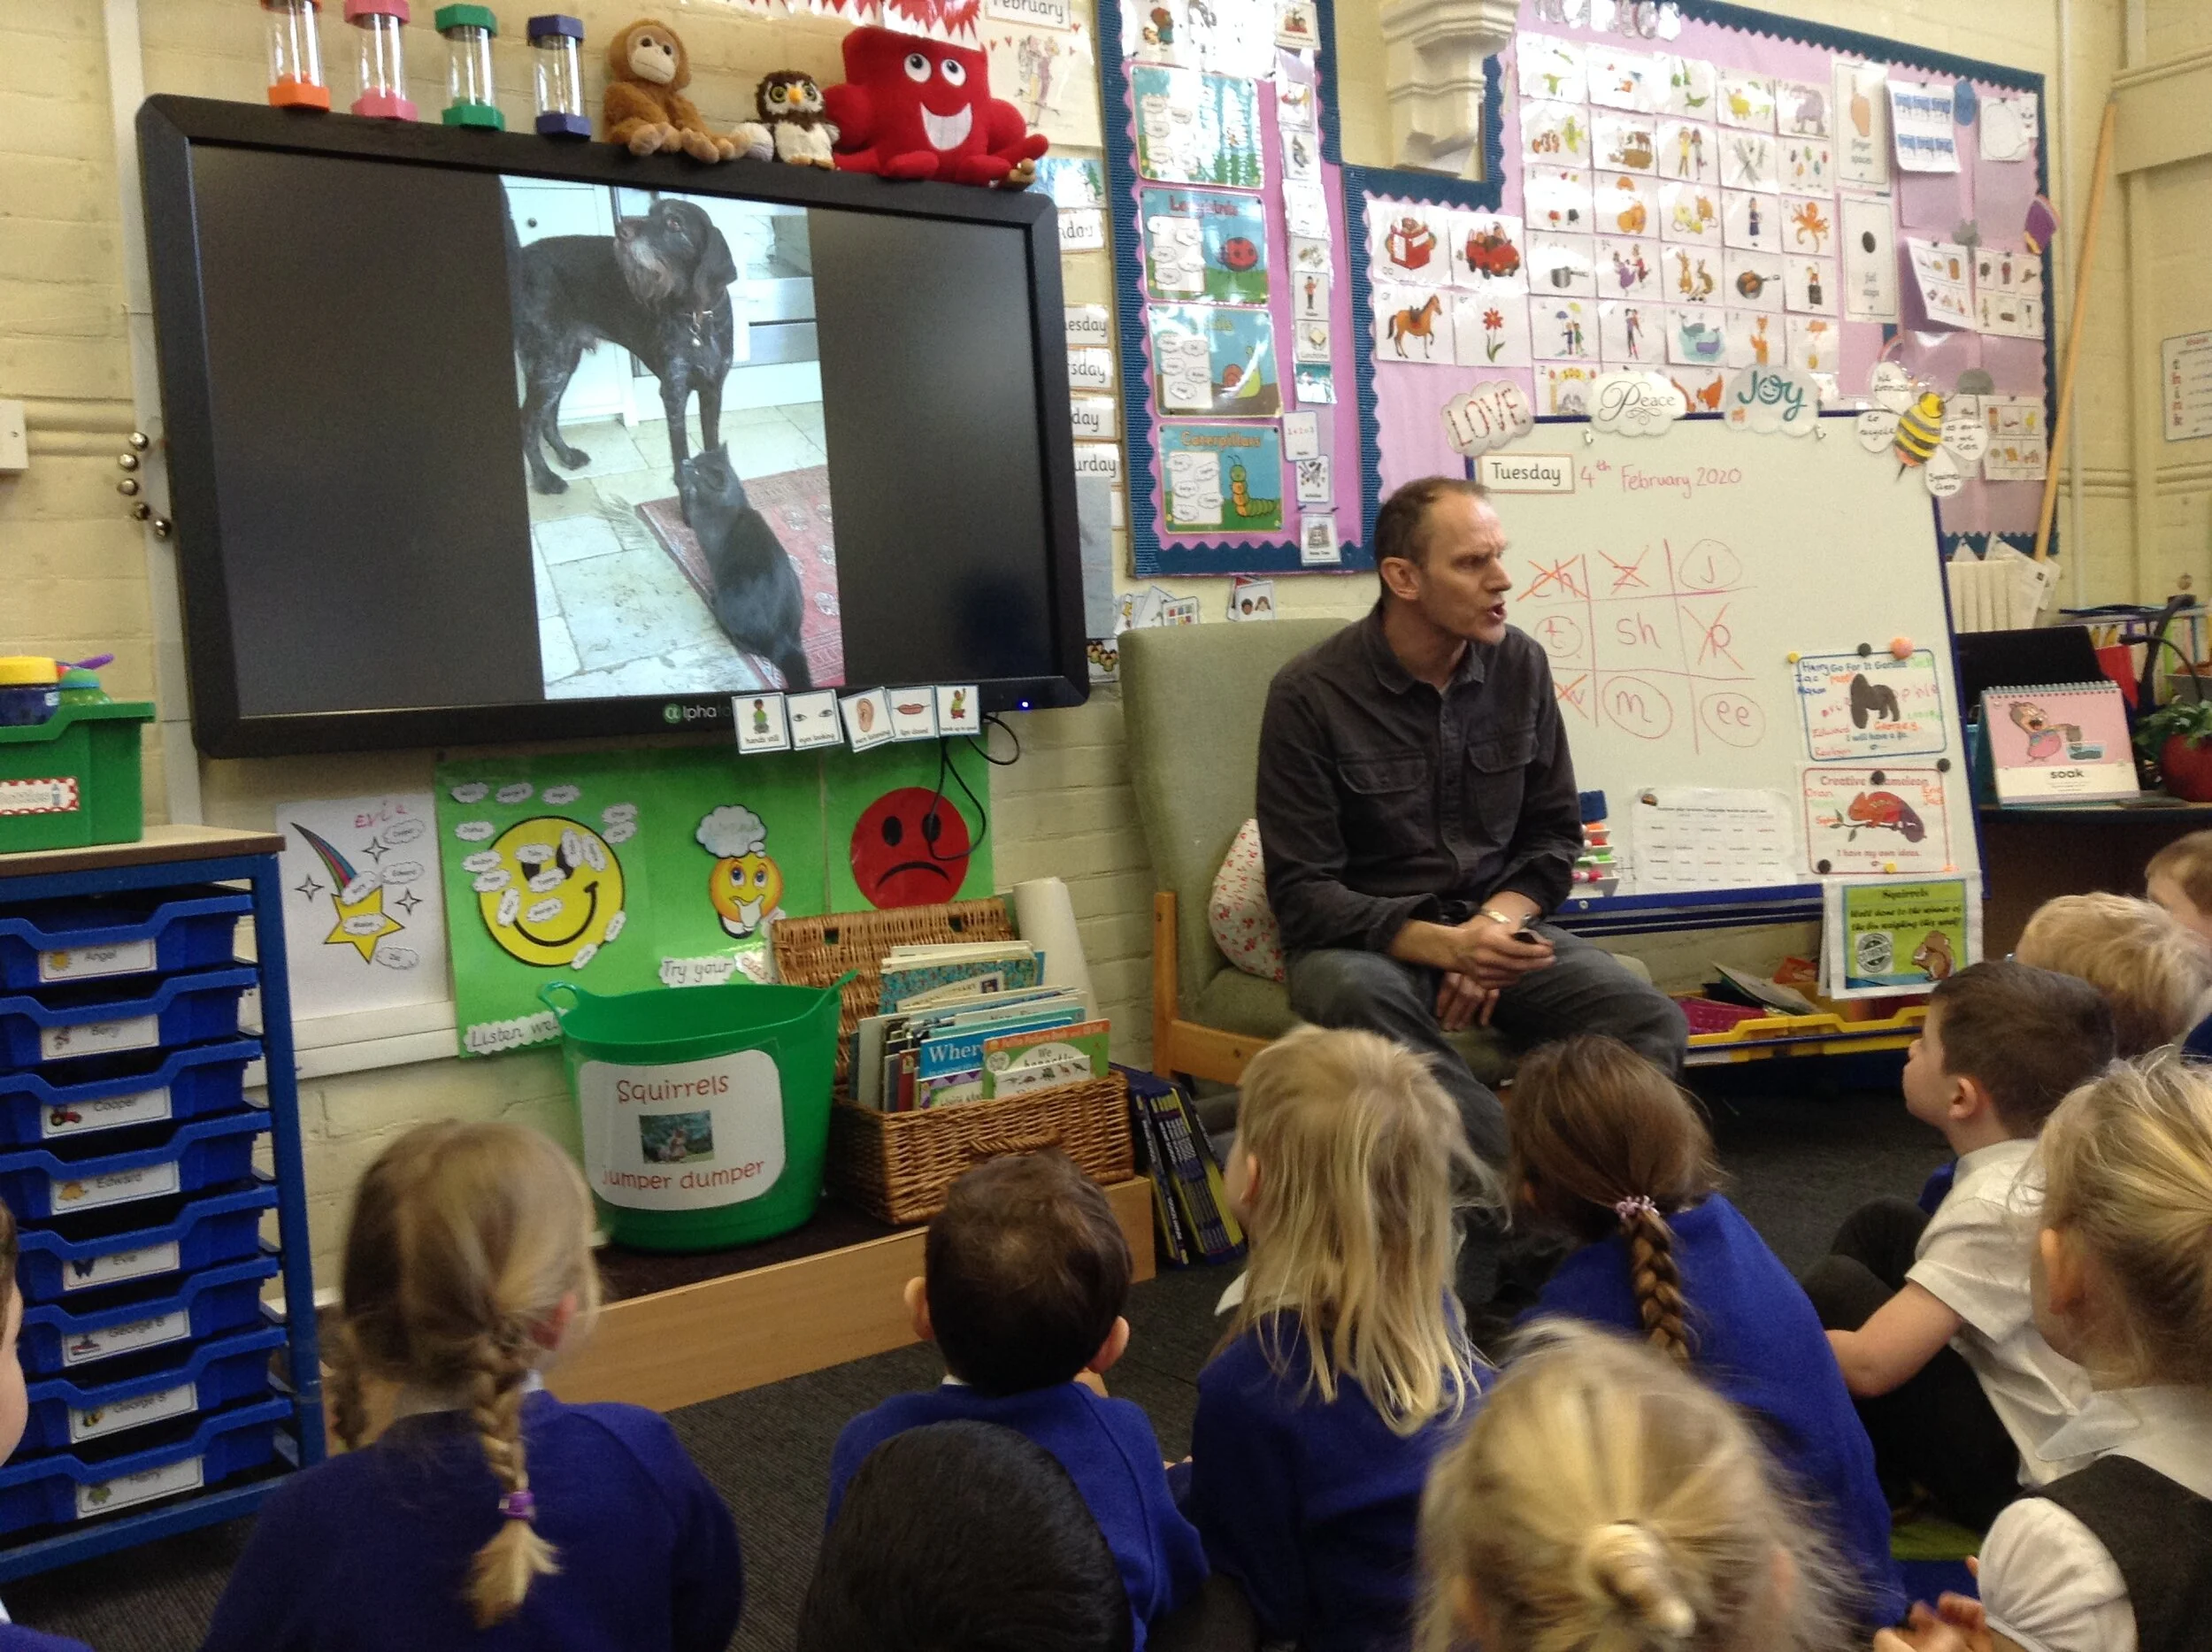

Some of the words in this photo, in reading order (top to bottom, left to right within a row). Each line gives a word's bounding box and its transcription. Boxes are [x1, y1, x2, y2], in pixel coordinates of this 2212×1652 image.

[993, 0, 1064, 24] ebruary
[1599, 380, 1676, 422] Peace
[1072, 407, 1099, 433] day
[1451, 388, 1526, 447] LOVE
[1074, 455, 1117, 479] urday
[1490, 462, 1562, 487] Tuesday
[1621, 464, 1692, 499] February
[1696, 466, 1742, 488] 2020
[1616, 690, 1653, 723] m
[1716, 700, 1751, 727] ee
[2050, 768, 2085, 780] soak
[471, 1023, 524, 1049] Listen
[930, 1041, 983, 1064] Wher
[616, 1074, 730, 1105] Squirrels
[602, 1164, 673, 1191] jumper
[680, 1158, 765, 1191] dumper
